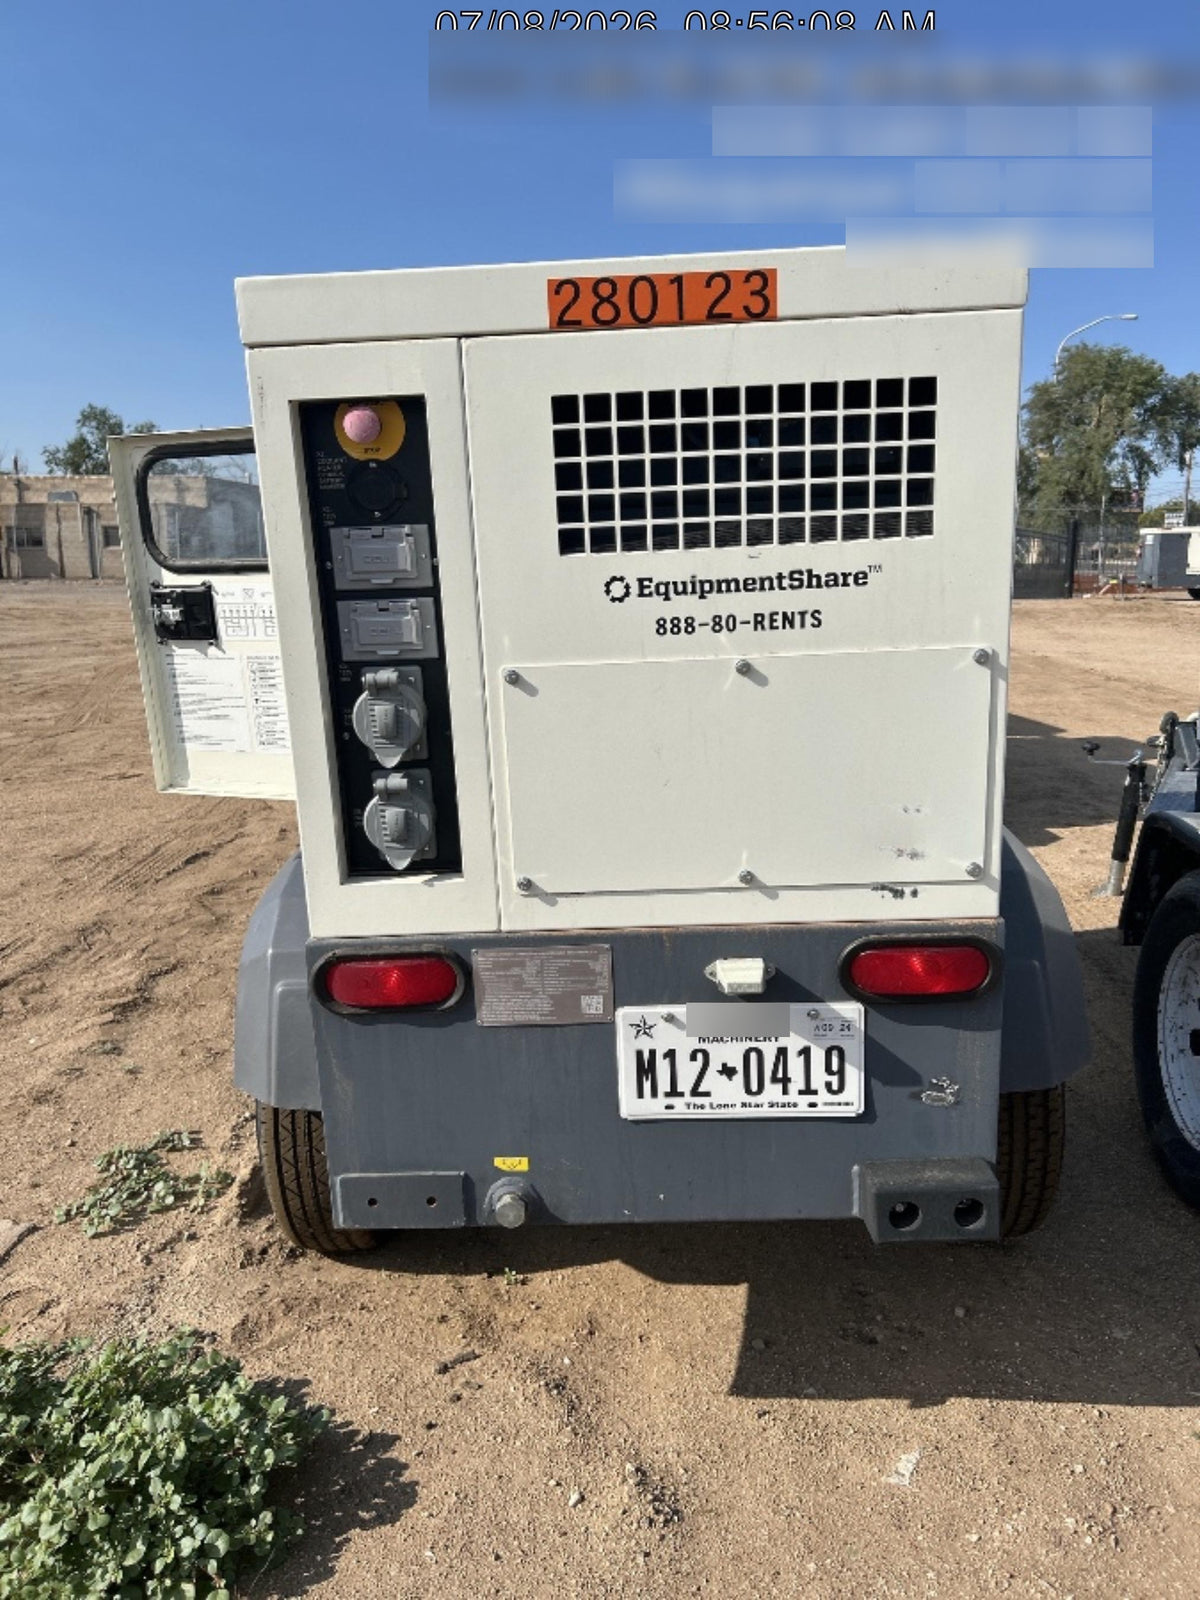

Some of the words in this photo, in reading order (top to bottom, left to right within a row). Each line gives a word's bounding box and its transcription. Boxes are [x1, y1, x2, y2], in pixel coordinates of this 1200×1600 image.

[552, 269, 771, 327] 280123
[636, 568, 869, 601] EquipmentShare
[655, 609, 823, 636] 888-80-RENTS
[742, 1045, 846, 1096] 0419
[685, 1101, 705, 1110] The
[767, 1101, 799, 1109] State
